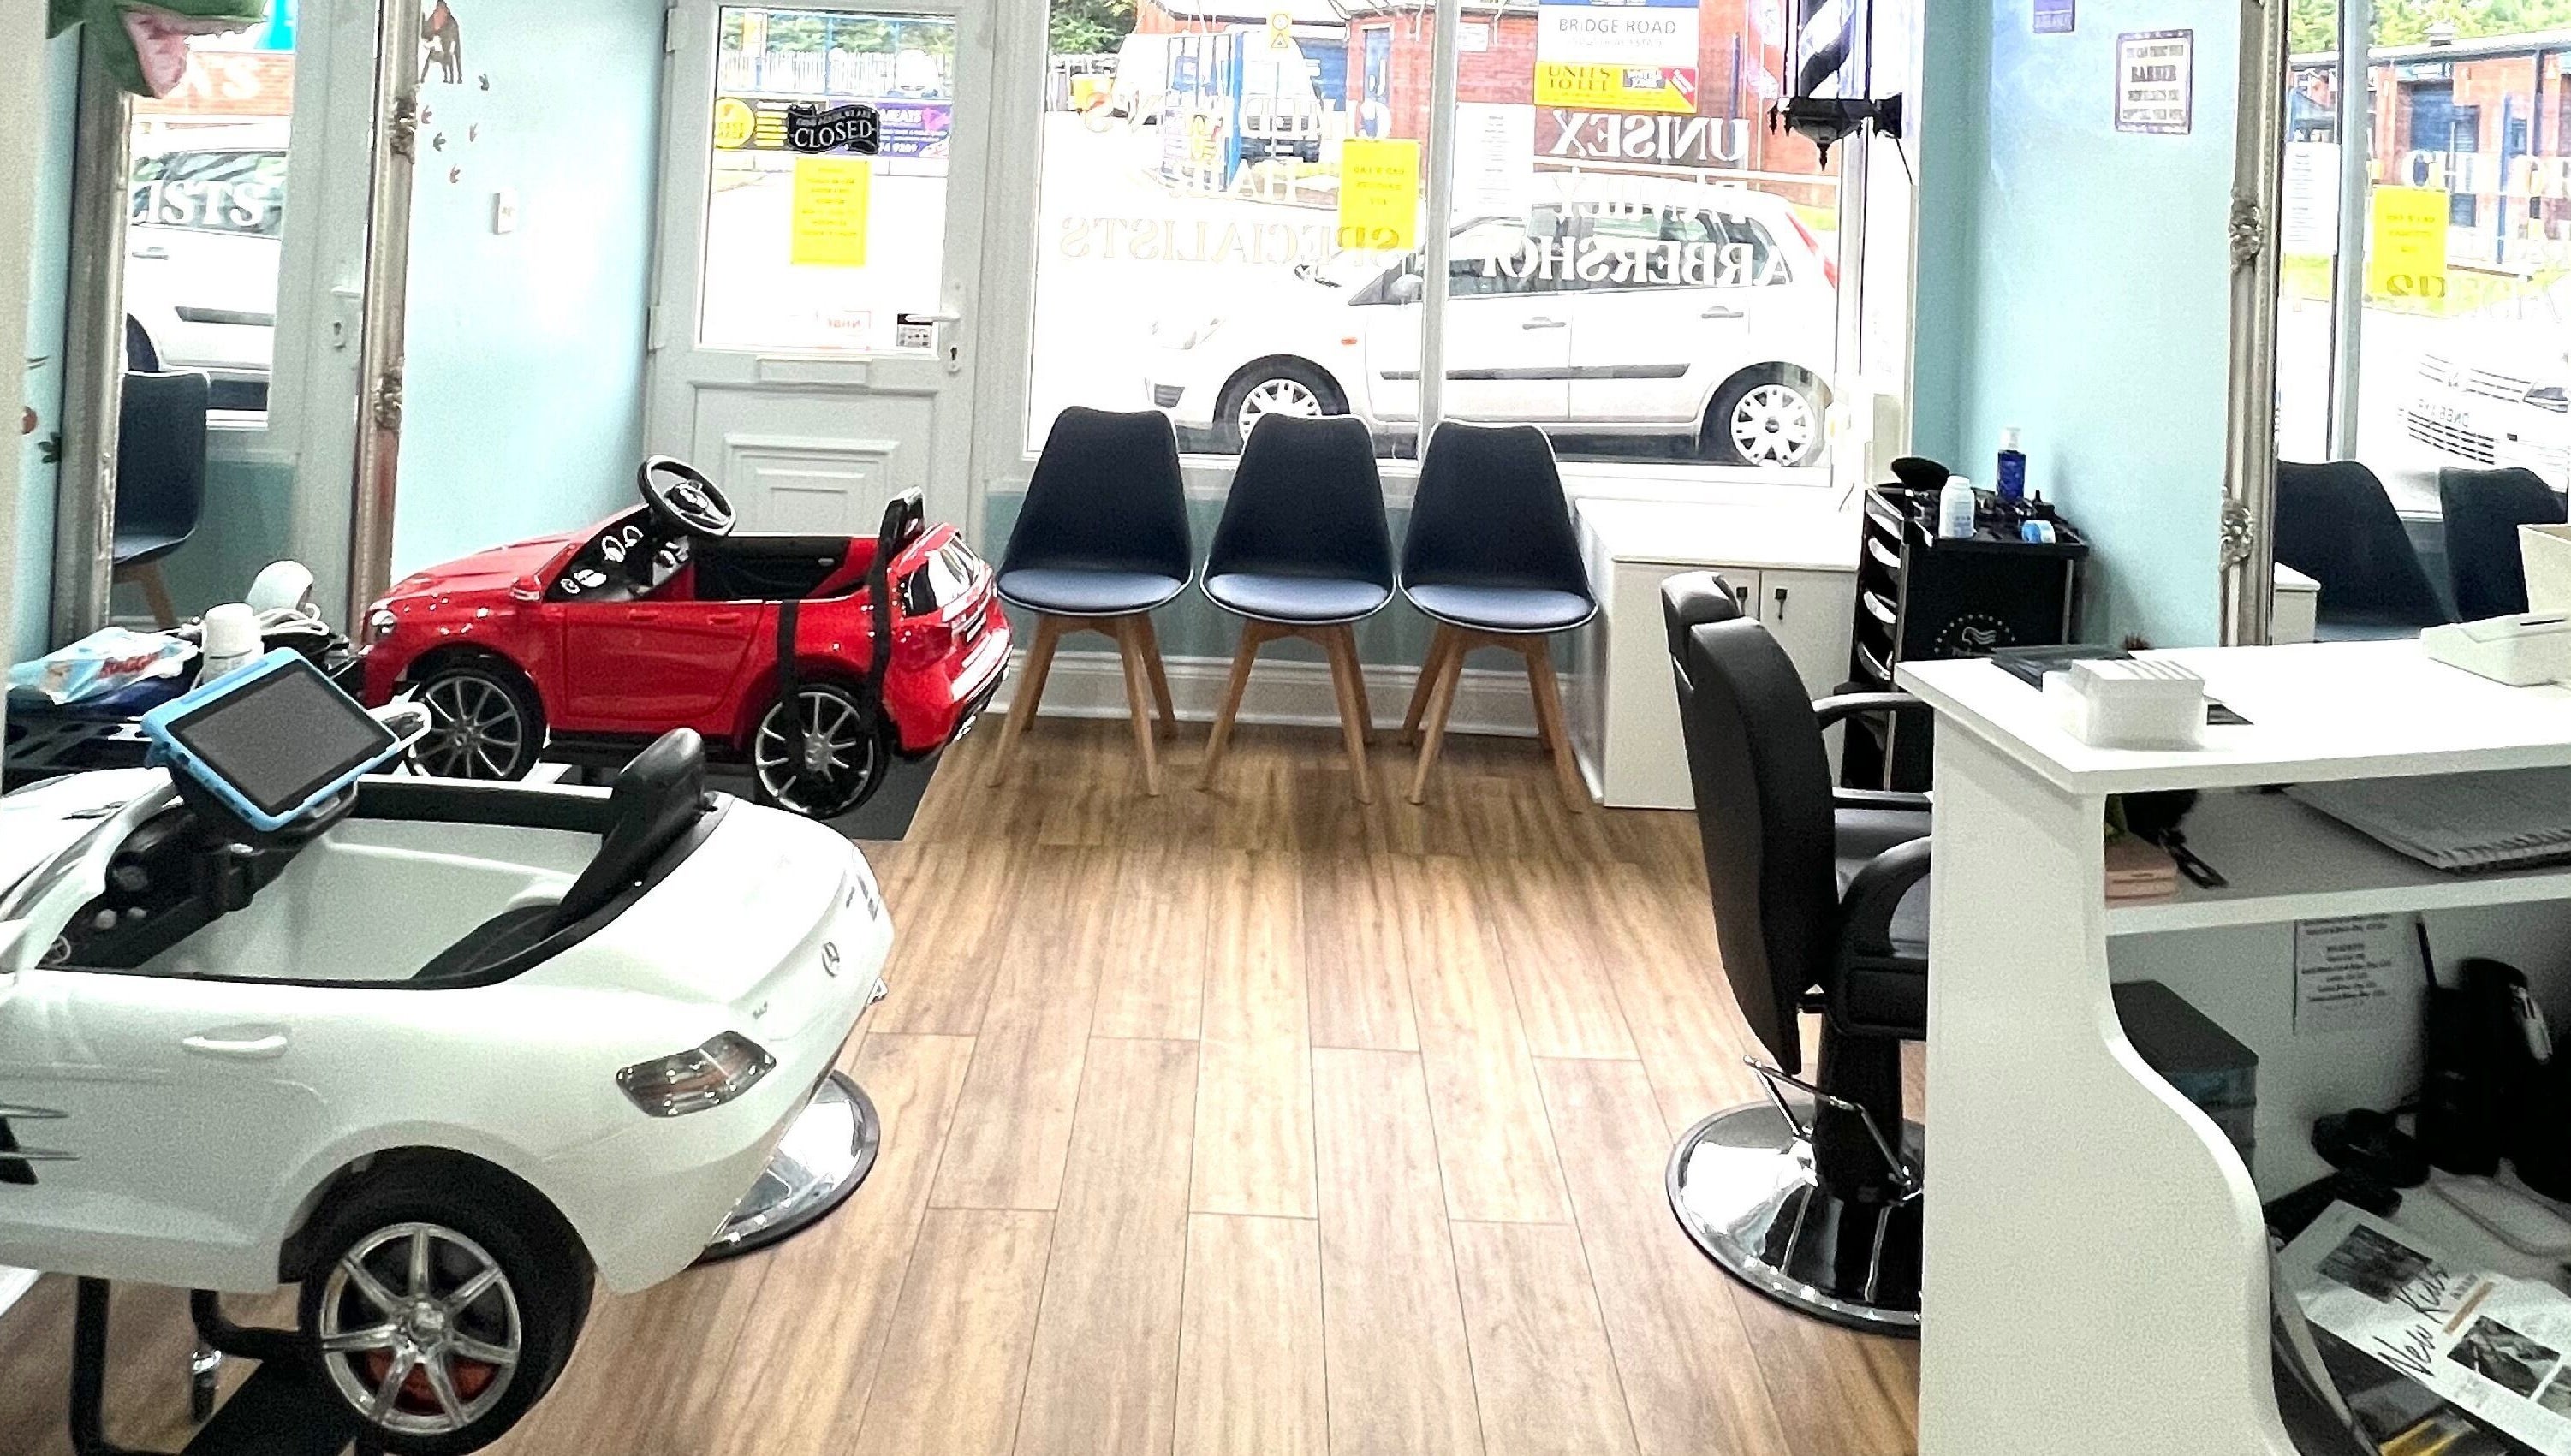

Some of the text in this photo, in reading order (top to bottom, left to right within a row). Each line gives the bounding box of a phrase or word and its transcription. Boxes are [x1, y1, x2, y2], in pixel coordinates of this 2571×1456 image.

[1559, 18, 1676, 34] BRIDGE ROAD
[1549, 66, 1610, 78] UNITS
[794, 119, 873, 148] CLOSED
